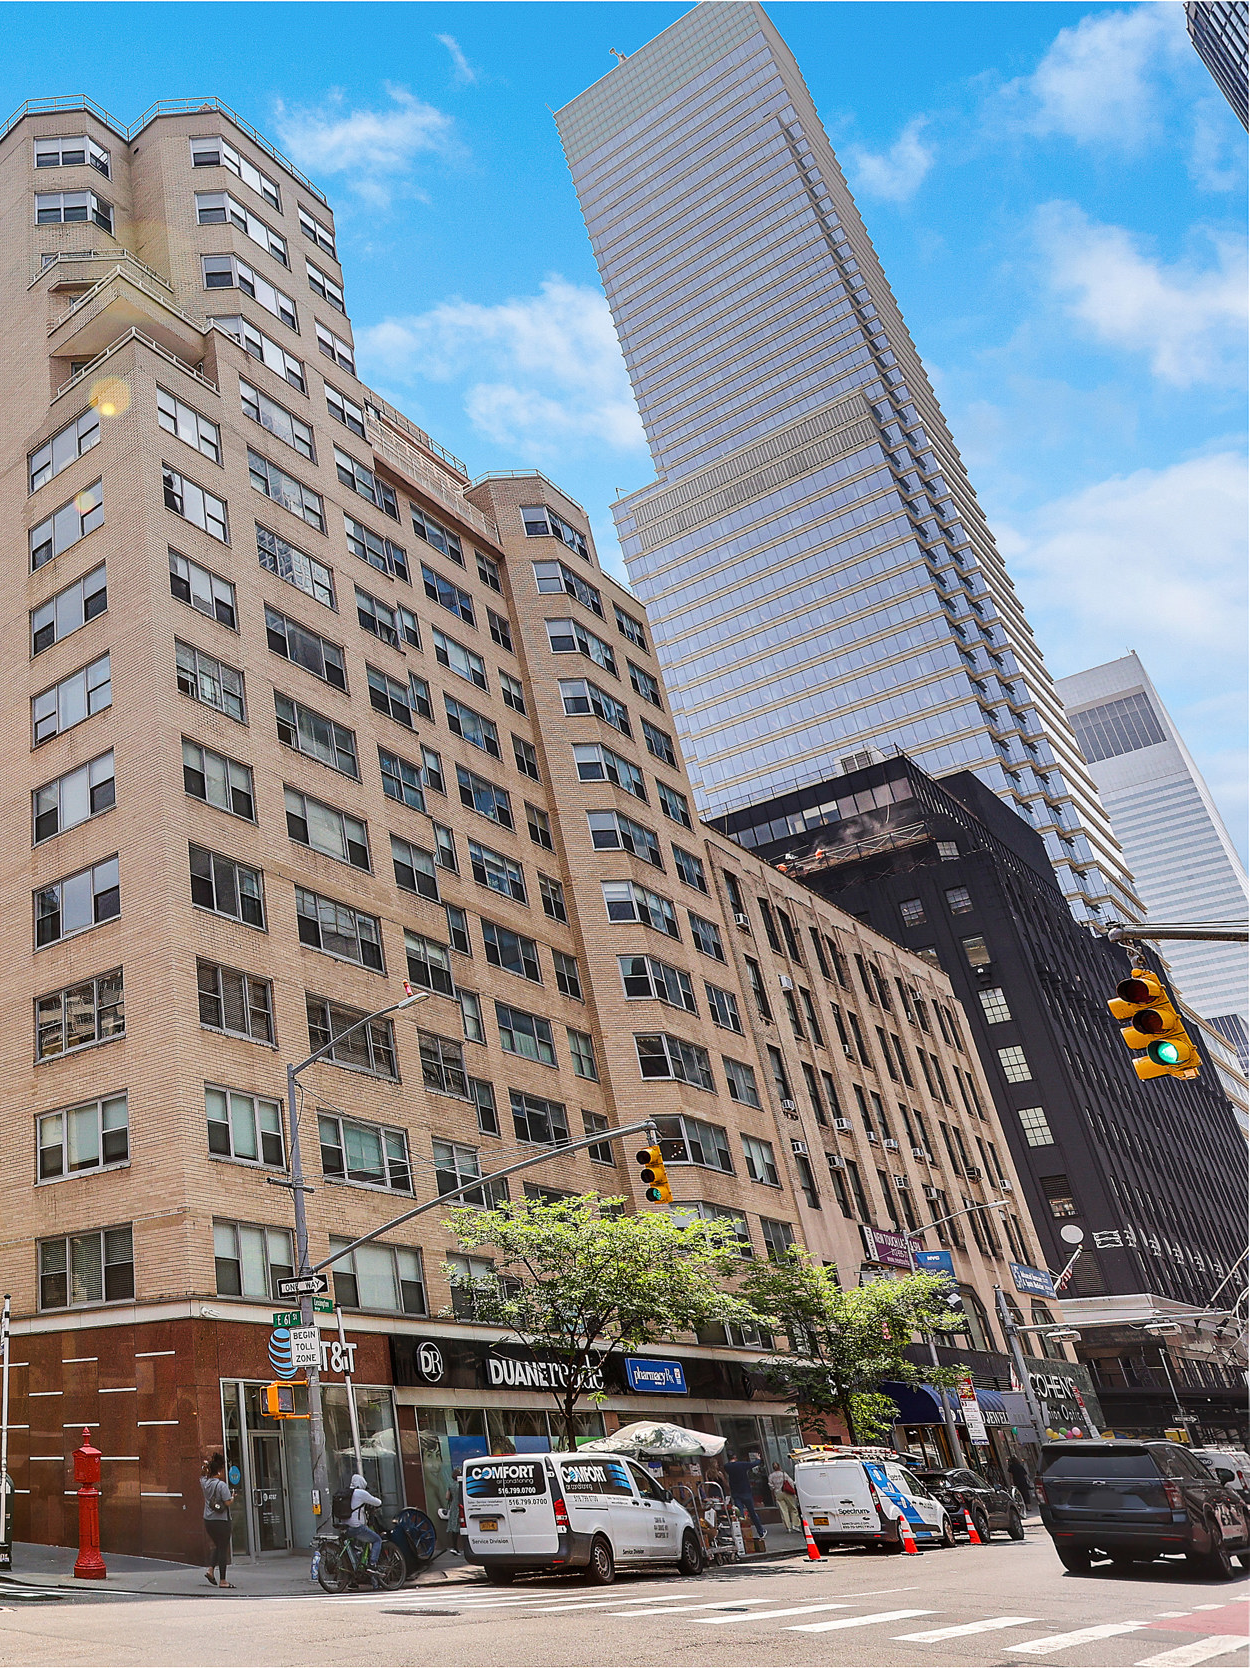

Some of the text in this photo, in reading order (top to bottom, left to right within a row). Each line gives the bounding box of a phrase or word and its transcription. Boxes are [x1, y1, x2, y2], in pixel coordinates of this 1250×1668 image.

[285, 1280, 320, 1292] ONE WAY
[313, 1298, 330, 1308] Lexington
[277, 1315, 282, 1326] E
[283, 1313, 291, 1325] 61
[293, 1330, 316, 1340] BEGIN
[295, 1342, 315, 1351] TOLL
[295, 1353, 317, 1363] ZONE
[305, 1341, 357, 1373] T&T
[633, 1366, 666, 1386] pharmacy
[472, 1464, 535, 1480] COMFORT
[561, 1465, 607, 1483] COMFORT
[498, 1486, 536, 1495] 516.799.0700
[509, 1498, 548, 1506] 516.799.0700
